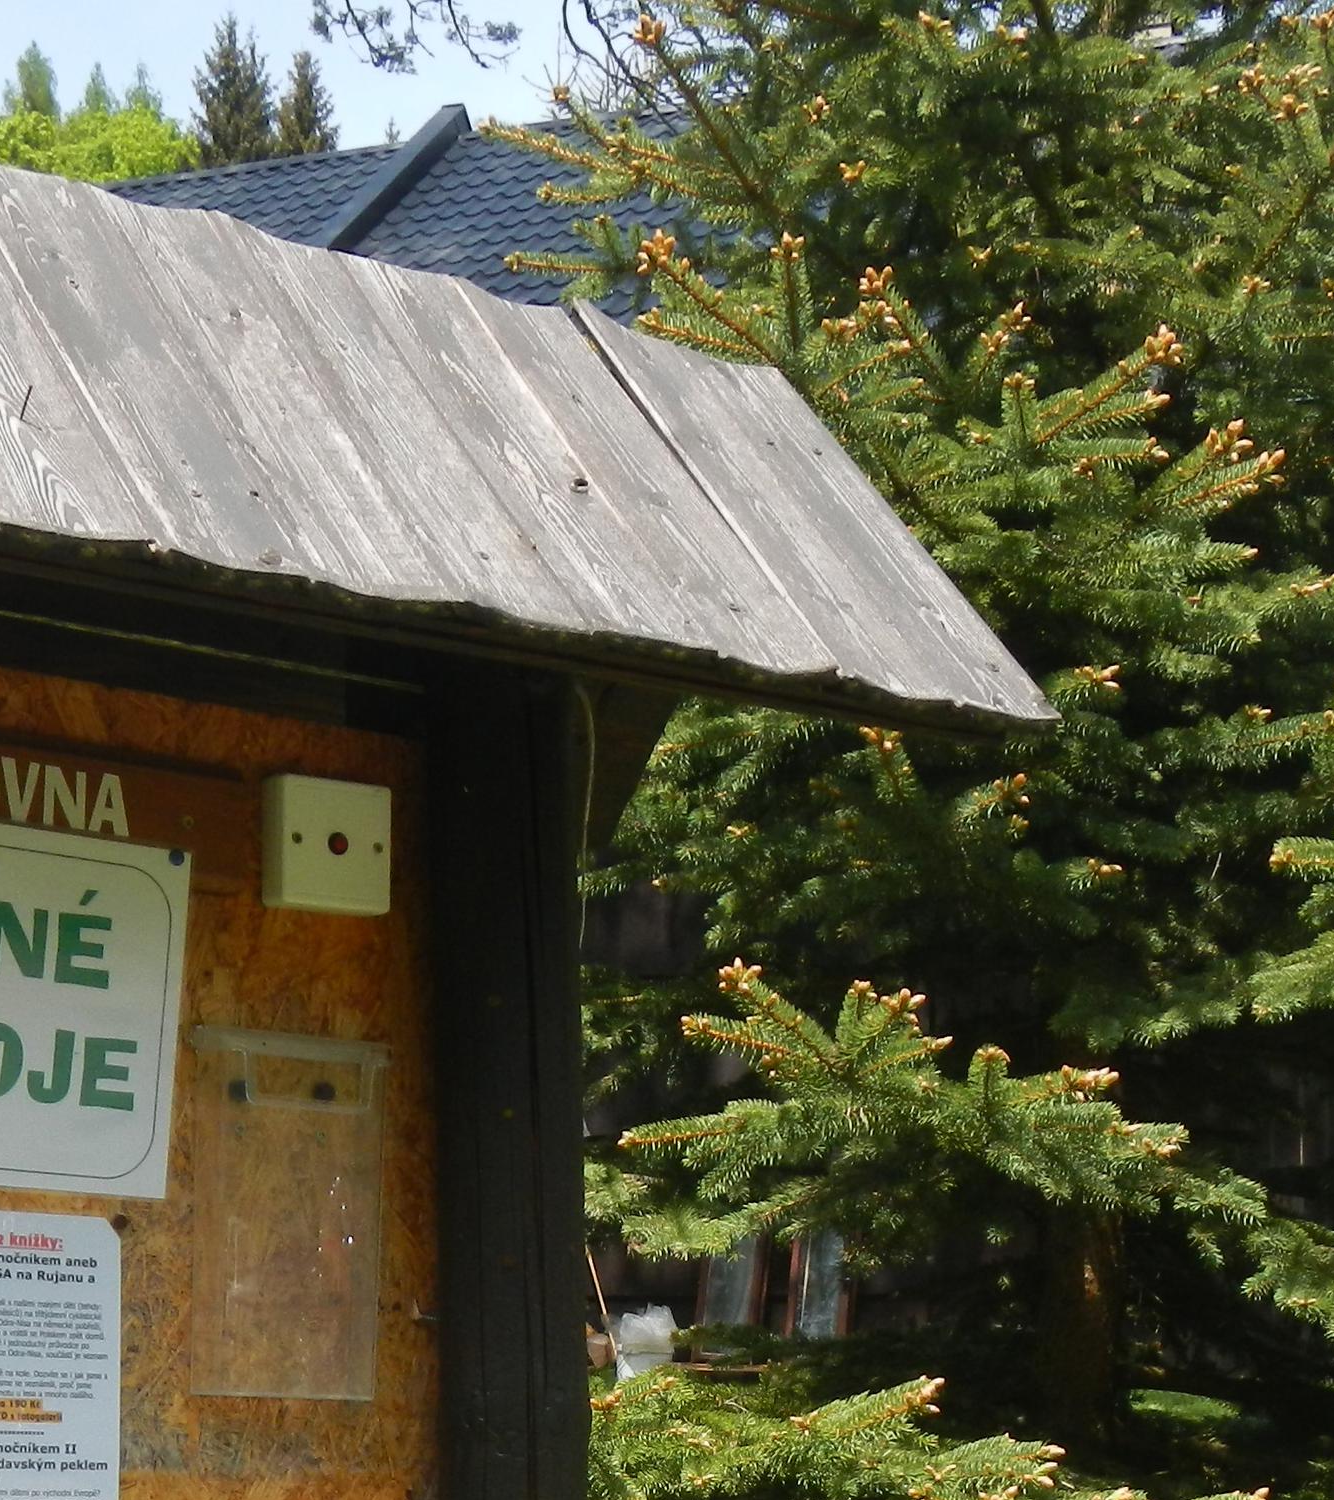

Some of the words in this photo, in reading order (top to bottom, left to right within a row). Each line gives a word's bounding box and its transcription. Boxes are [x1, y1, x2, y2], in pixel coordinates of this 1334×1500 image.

[10, 1232, 63, 1250] knížky:
[65, 1256, 97, 1268] aneb
[16, 1271, 32, 1280] na
[37, 1270, 83, 1284] Rujanu
[87, 1274, 95, 1283] a
[64, 1443, 76, 1454] II
[60, 1459, 107, 1472] peklem
